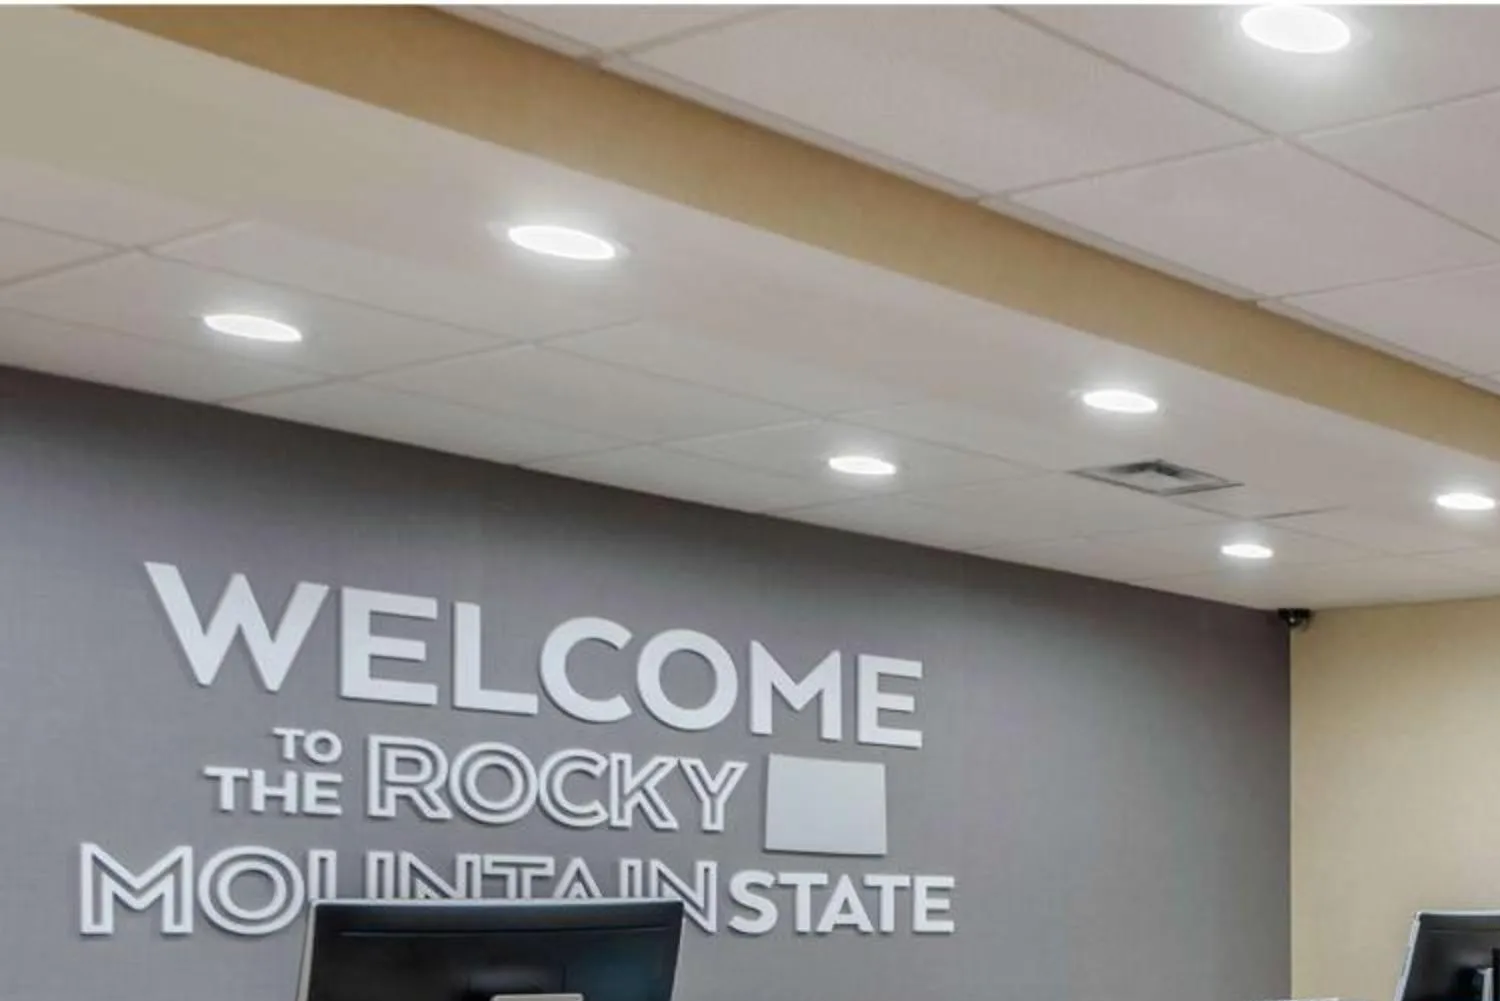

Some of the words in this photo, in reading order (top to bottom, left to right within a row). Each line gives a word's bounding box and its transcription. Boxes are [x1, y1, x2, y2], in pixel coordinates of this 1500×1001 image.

[144, 561, 923, 748] WELCOME
[204, 766, 343, 816] THE
[366, 734, 749, 833] ROCKY
[273, 727, 342, 764] TO
[729, 871, 956, 934] STATE
